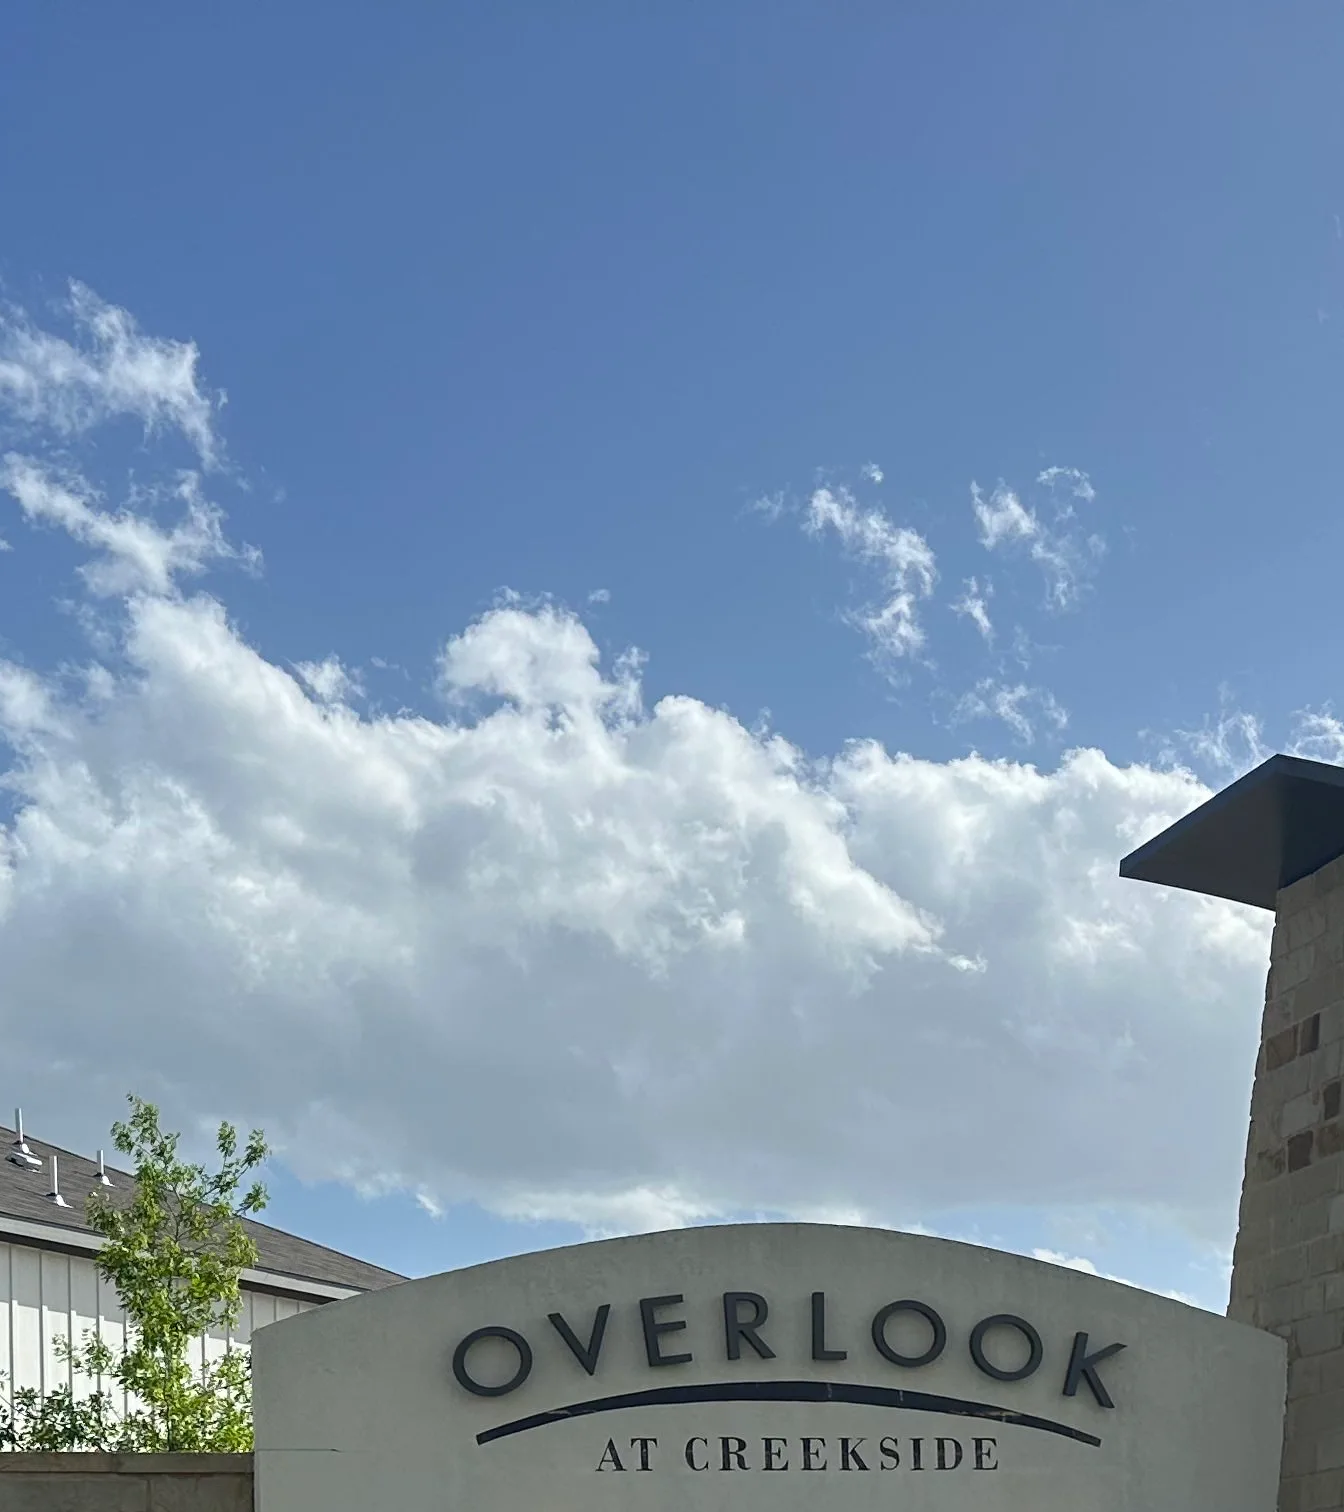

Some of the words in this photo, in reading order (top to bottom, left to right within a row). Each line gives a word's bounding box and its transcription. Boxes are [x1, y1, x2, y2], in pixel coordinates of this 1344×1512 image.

[452, 1291, 1127, 1409] OVERLOOK
[596, 1437, 657, 1473] AT
[685, 1436, 1001, 1472] CREEKSIDE
